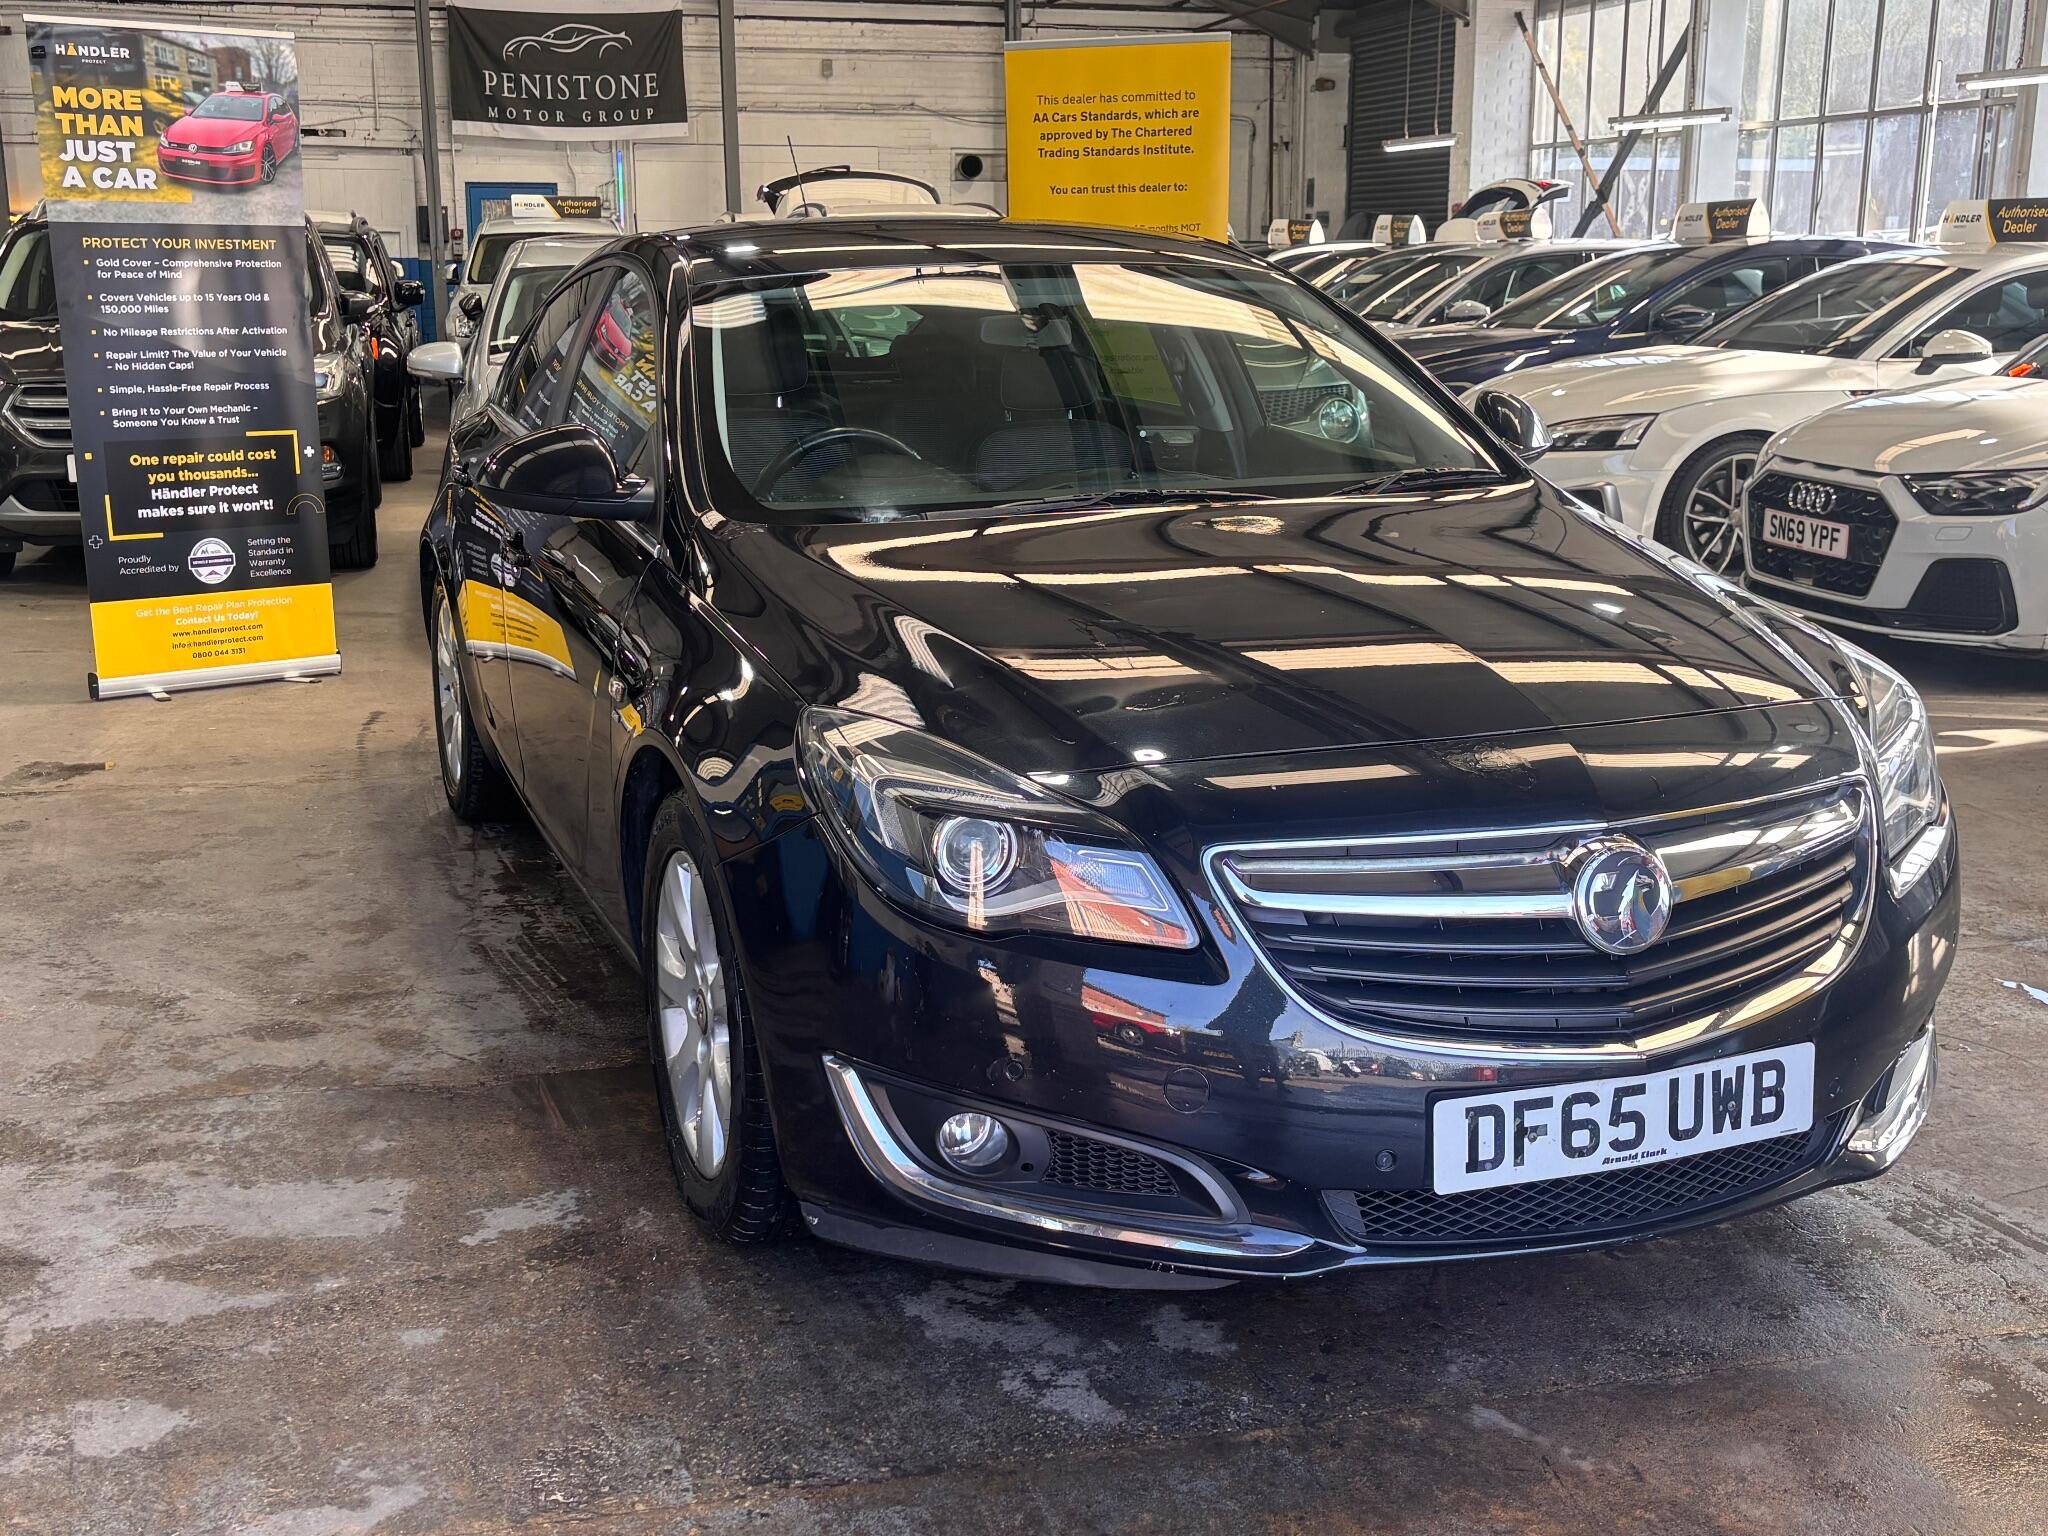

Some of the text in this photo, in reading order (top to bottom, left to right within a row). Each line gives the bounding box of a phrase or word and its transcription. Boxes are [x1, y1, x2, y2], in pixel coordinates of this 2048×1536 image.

[482, 70, 658, 100] PENISTONE
[53, 86, 143, 110] MORE
[1037, 90, 1196, 105] This dealer has committed to
[488, 107, 655, 122] MOTOR GROUP
[1033, 109, 1199, 122] AA Cars Standards, which are
[55, 112, 143, 137] THAN
[1040, 126, 1192, 141] approved by The Chartered
[59, 140, 135, 162] JUST
[1038, 145, 1194, 159] Trading Standards Institute.
[62, 166, 157, 189] A CAR
[1050, 183, 1187, 195] You can trust this dealer to:
[557, 199, 596, 207] Authorised
[1181, 224, 1200, 232] MOT
[1716, 218, 1739, 229] Dealer
[2003, 219, 2037, 233] Dealer
[82, 237, 276, 250] PROTECT YOUR INVESTMENT
[96, 259, 119, 267] Gold
[122, 259, 151, 267] Cover
[162, 259, 232, 269] Comprehensive
[236, 260, 281, 268] Protection
[98, 270, 182, 279] for Peace of Mind
[100, 294, 134, 302] Covers
[137, 294, 177, 302] Vehicles
[179, 295, 191, 304] up
[193, 294, 202, 302] to
[217, 294, 242, 302] Years
[245, 293, 261, 301] Old
[101, 305, 168, 314] 150,000 Miles
[104, 327, 287, 338] No Mileage Restrictions After Activation
[106, 348, 286, 360] Repair Limit? The Value of Your Vehicle
[115, 362, 129, 370] No
[132, 362, 166, 370] Hidden
[169, 362, 194, 371] Caps!
[109, 382, 269, 394] Simple, Hassle-Free Repair Process
[112, 408, 137, 418] Bring
[163, 407, 185, 415] Your
[188, 406, 208, 414] Own
[210, 405, 250, 413] Mechanic
[113, 419, 157, 428] Someone
[161, 418, 179, 426] You
[182, 417, 206, 426] Know
[217, 416, 239, 424] Trust
[130, 448, 276, 466] One repair could cost
[148, 471, 175, 484] you
[151, 484, 258, 500] Händler Protect
[138, 506, 184, 519] makes
[188, 504, 216, 515] sure
[220, 502, 228, 513] it
[1770, 514, 1840, 552] SN69 YPF
[248, 536, 290, 547] Setting the
[248, 546, 293, 556] Standard in
[118, 555, 151, 565] Proudly
[249, 558, 286, 568] Warranty
[120, 564, 179, 576] Accredited by
[250, 568, 291, 577] Excellence
[136, 596, 292, 618] Get the Best Repair Plan Protection
[176, 611, 258, 626] Contact Us Today!
[172, 623, 262, 637] www.handlerprotect.com
[192, 648, 246, 659] 0800 044 3131
[1465, 1058, 1786, 1174] DF65 UWB
[1602, 1148, 1667, 1165] Arnold Clark
